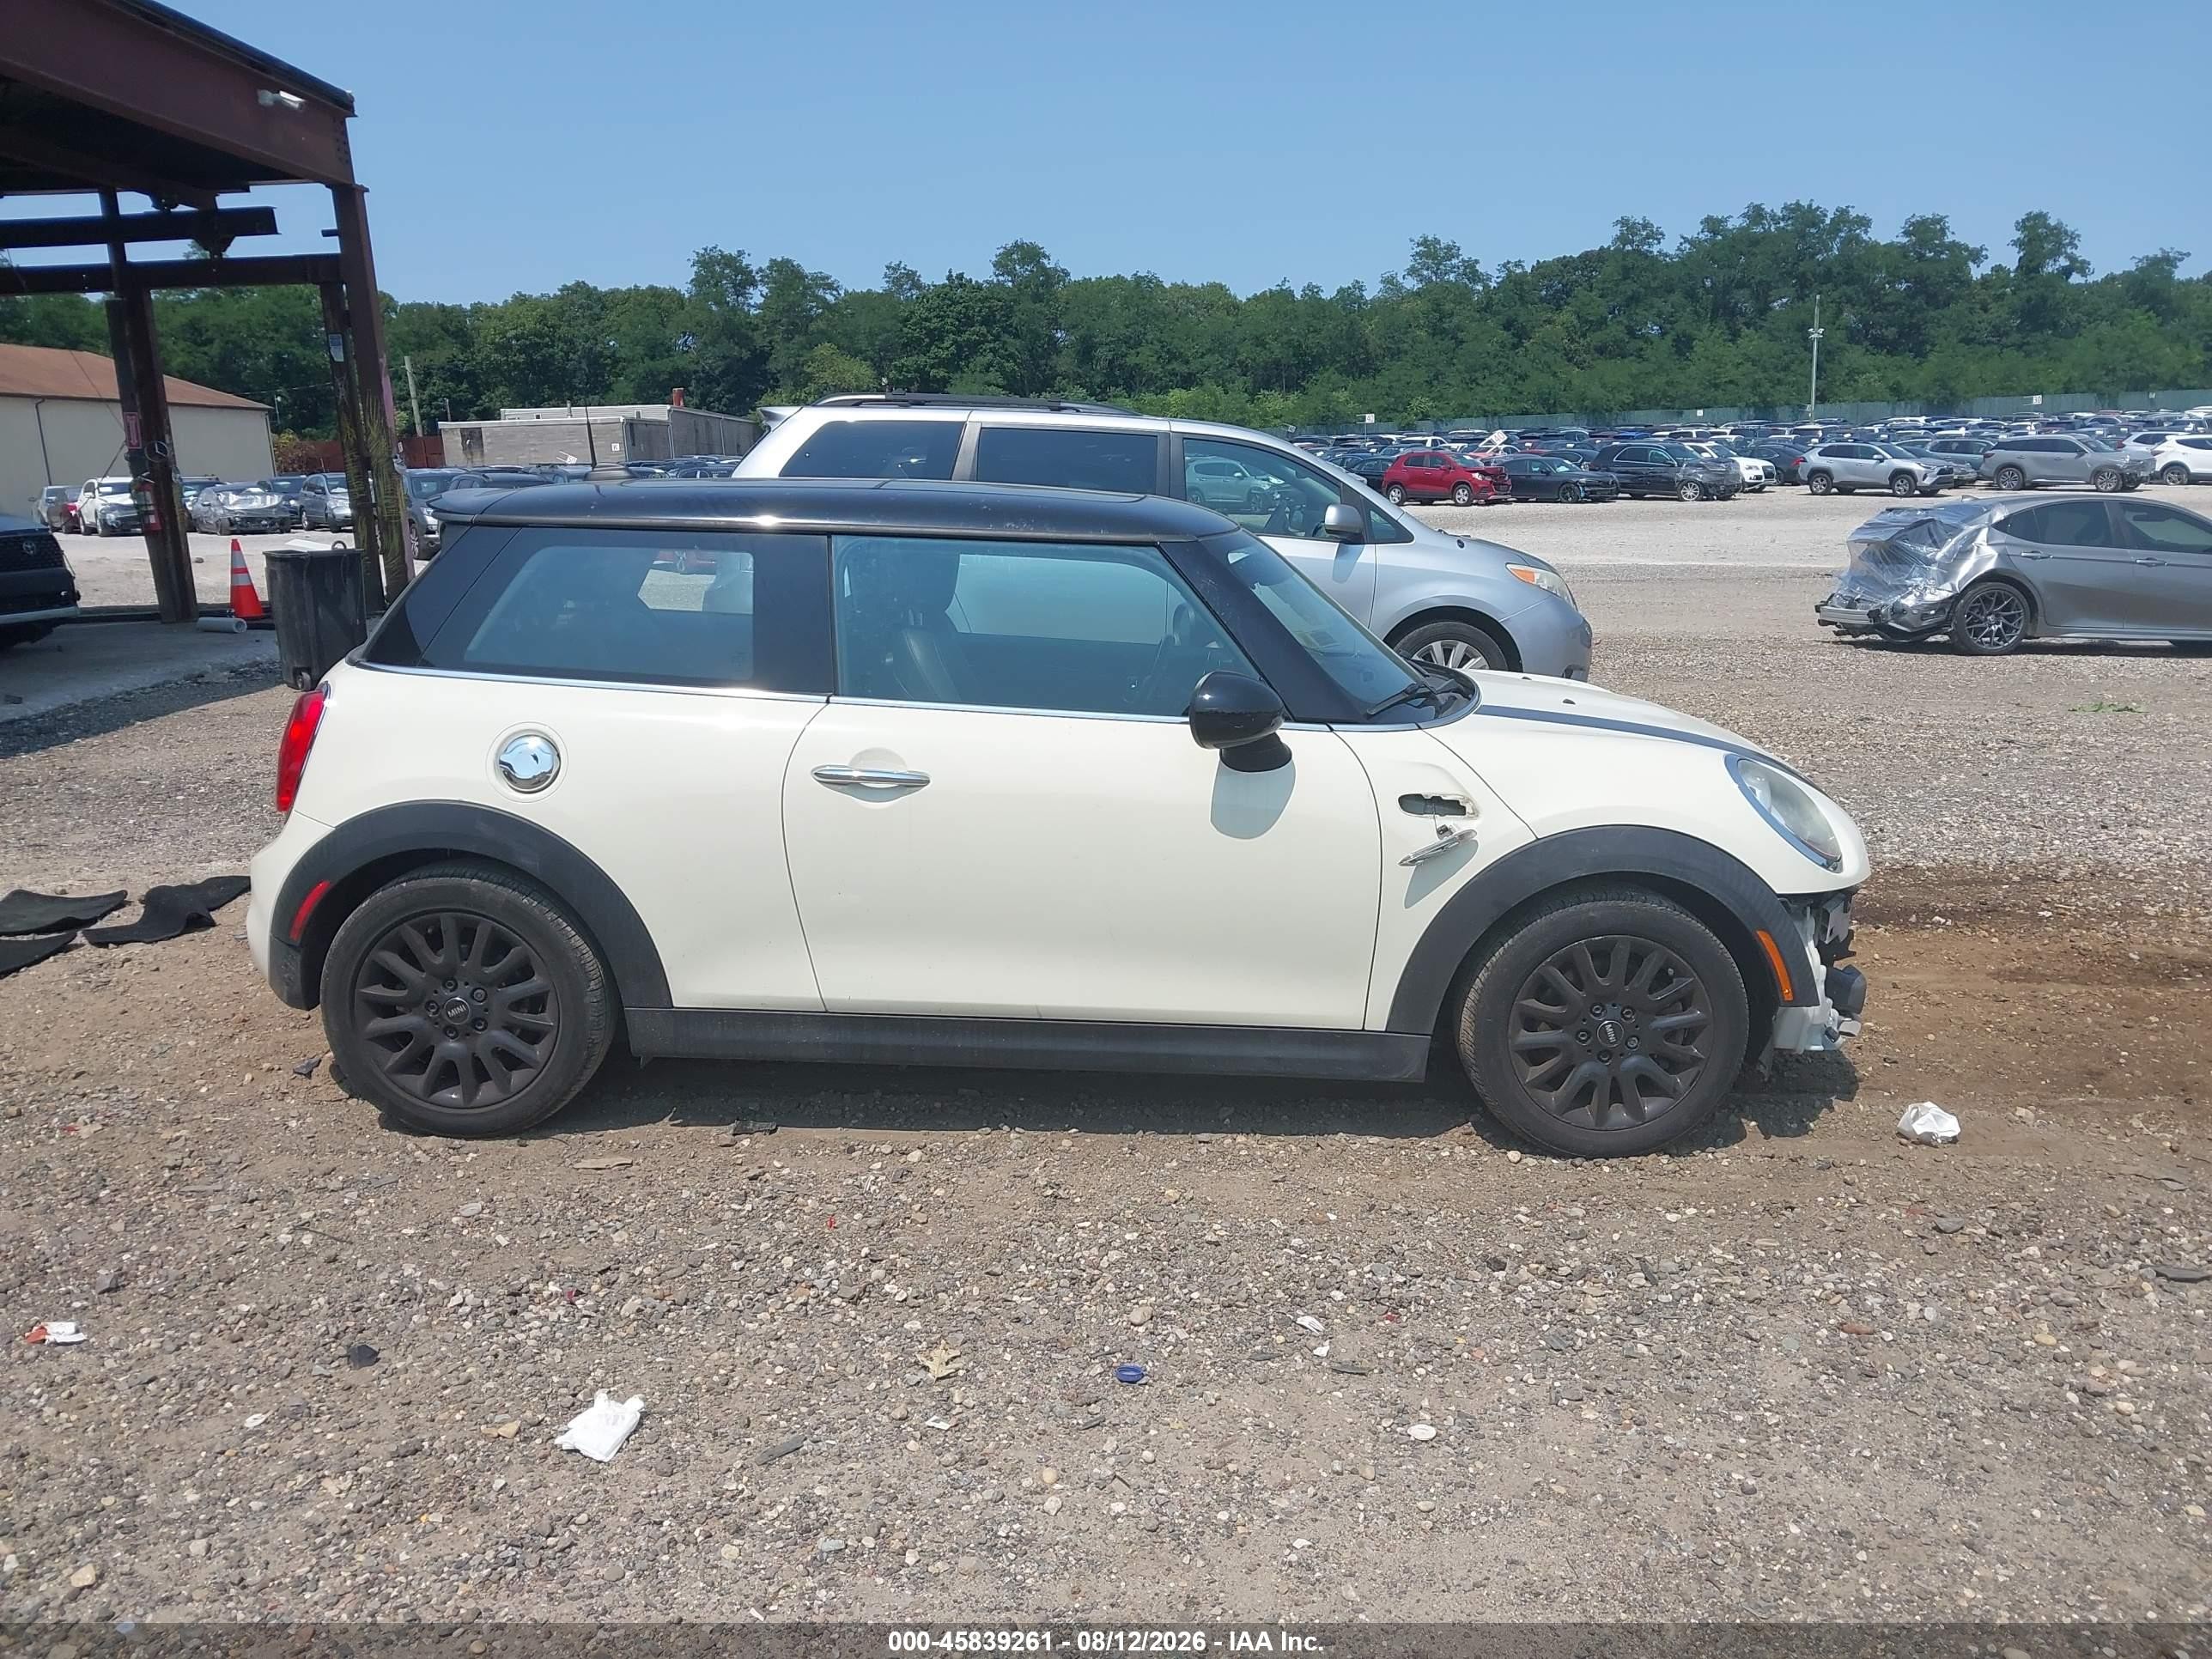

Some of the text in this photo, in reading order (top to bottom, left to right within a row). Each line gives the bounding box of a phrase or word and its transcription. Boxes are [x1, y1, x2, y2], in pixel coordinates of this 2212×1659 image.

[1366, 414, 1374, 422] 40
[447, 1004, 466, 1018] MINI
[1605, 1024, 1616, 1042] MINI
